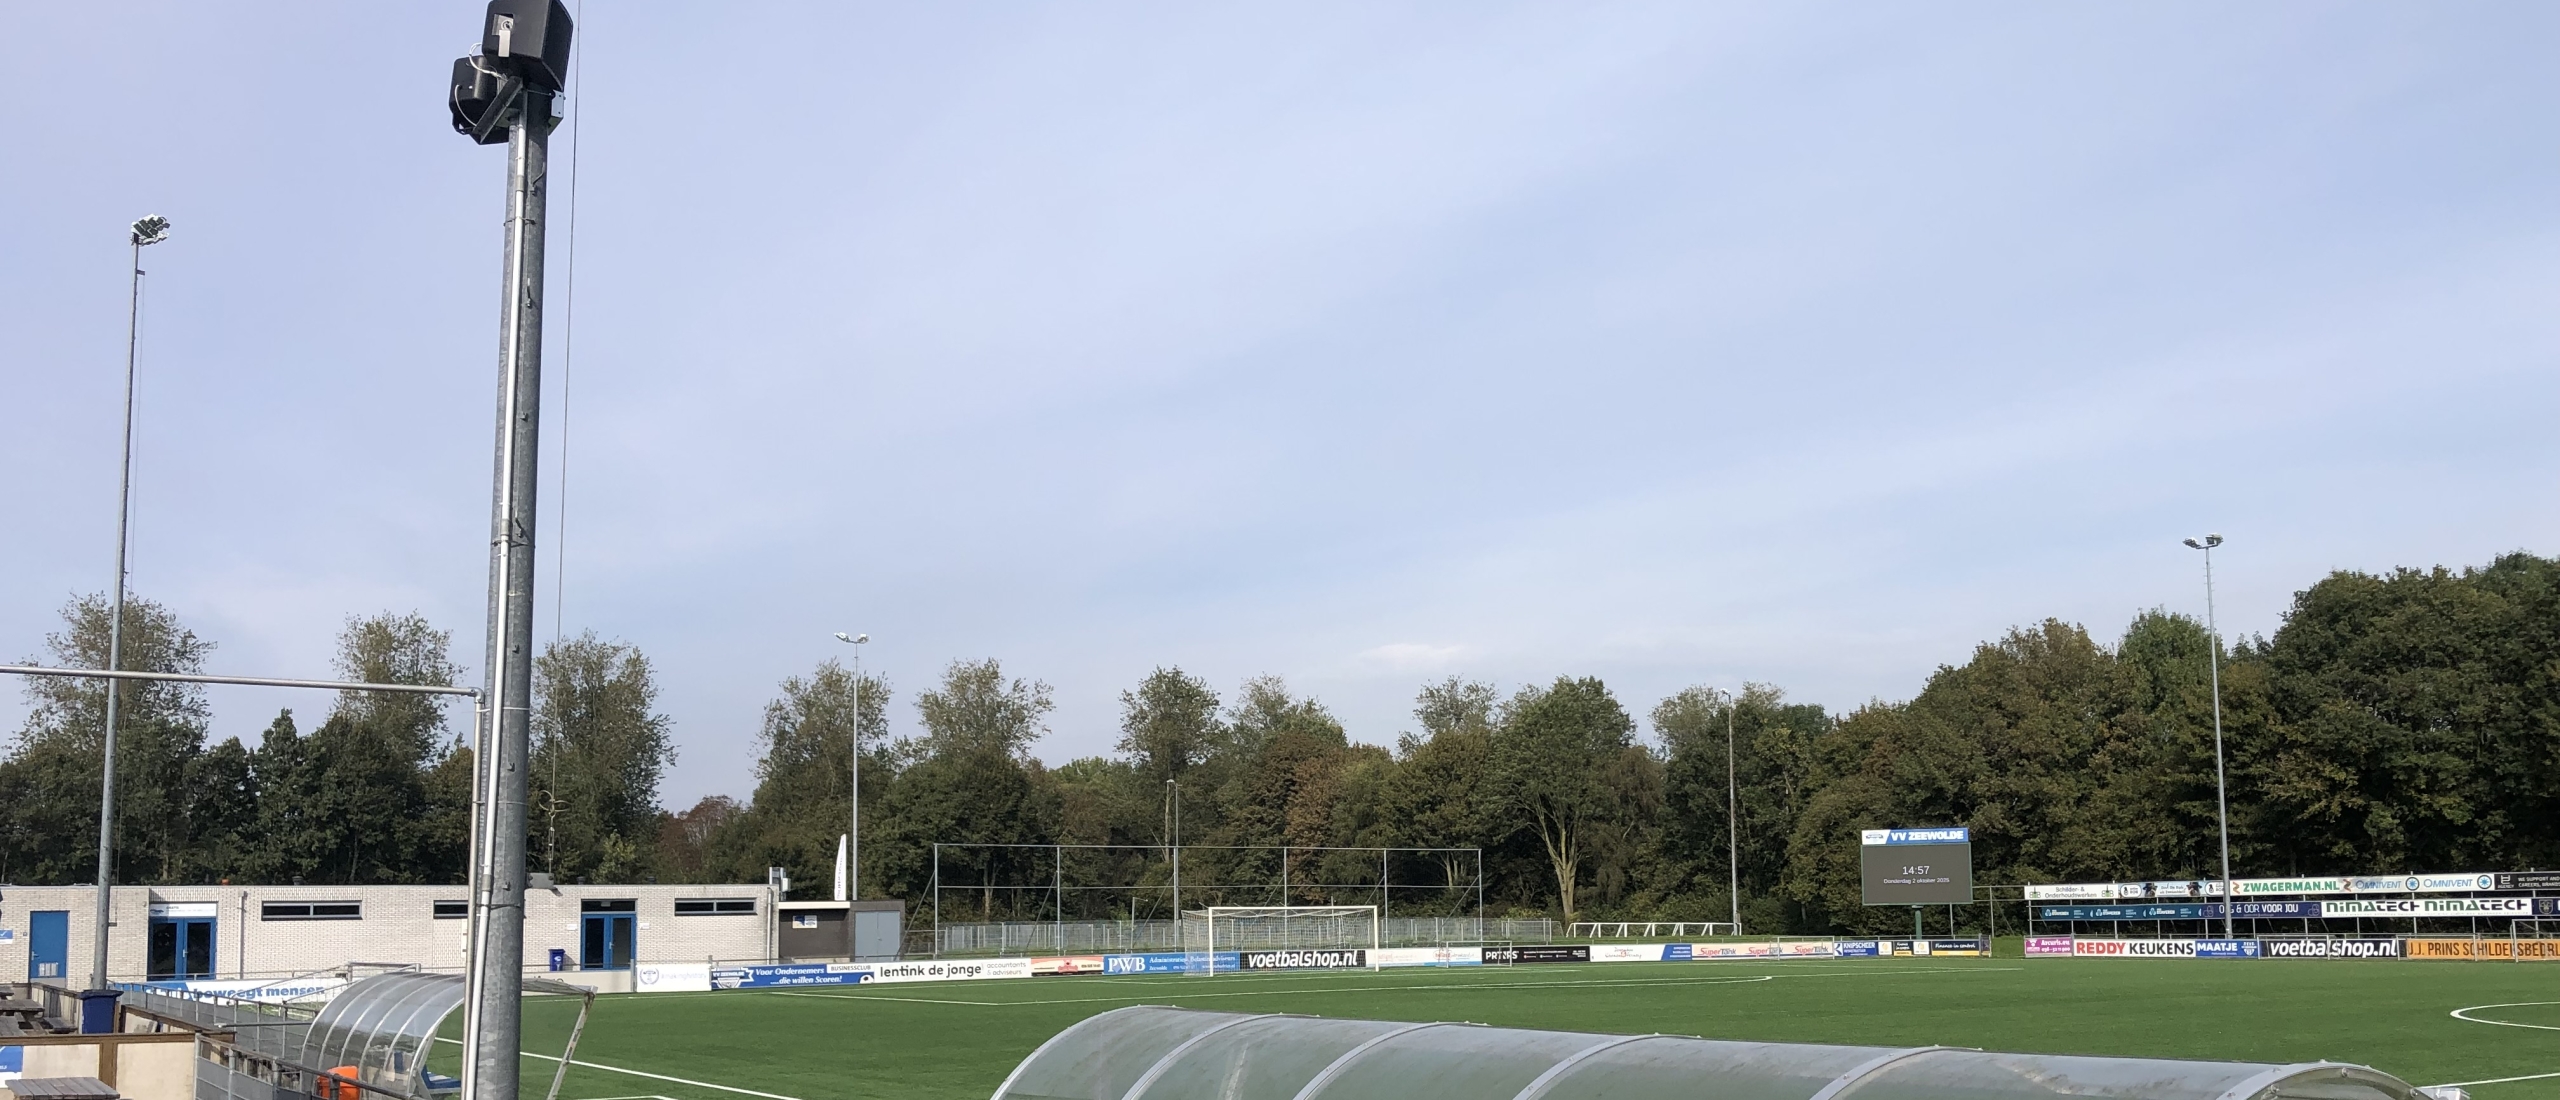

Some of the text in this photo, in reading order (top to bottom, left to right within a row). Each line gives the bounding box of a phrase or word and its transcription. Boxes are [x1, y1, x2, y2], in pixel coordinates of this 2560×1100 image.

[1891, 830, 1964, 841] VV ZEEWOLDE
[1902, 866, 1930, 875] 14:57
[2243, 881, 2340, 892] ZWAGERMAN.NL
[2424, 879, 2473, 888] OMNIVENT
[2045, 891, 2097, 899] Onderhoudswerken
[2236, 904, 2242, 913] &
[2261, 904, 2283, 913] VOOR
[2285, 904, 2299, 913] JOU
[2076, 942, 2194, 955] REDDY KEUKENS
[2197, 942, 2238, 951] MAATJE
[2409, 943, 2425, 955] J.J.
[2428, 942, 2460, 956] PRINS
[1248, 949, 1358, 968] voetbalshop.nl
[987, 961, 1026, 969] accountants
[1108, 957, 1145, 973] PWB
[756, 967, 825, 976] Voor Ondernemers
[880, 964, 982, 978] lentink de jonge
[792, 975, 814, 984] willen
